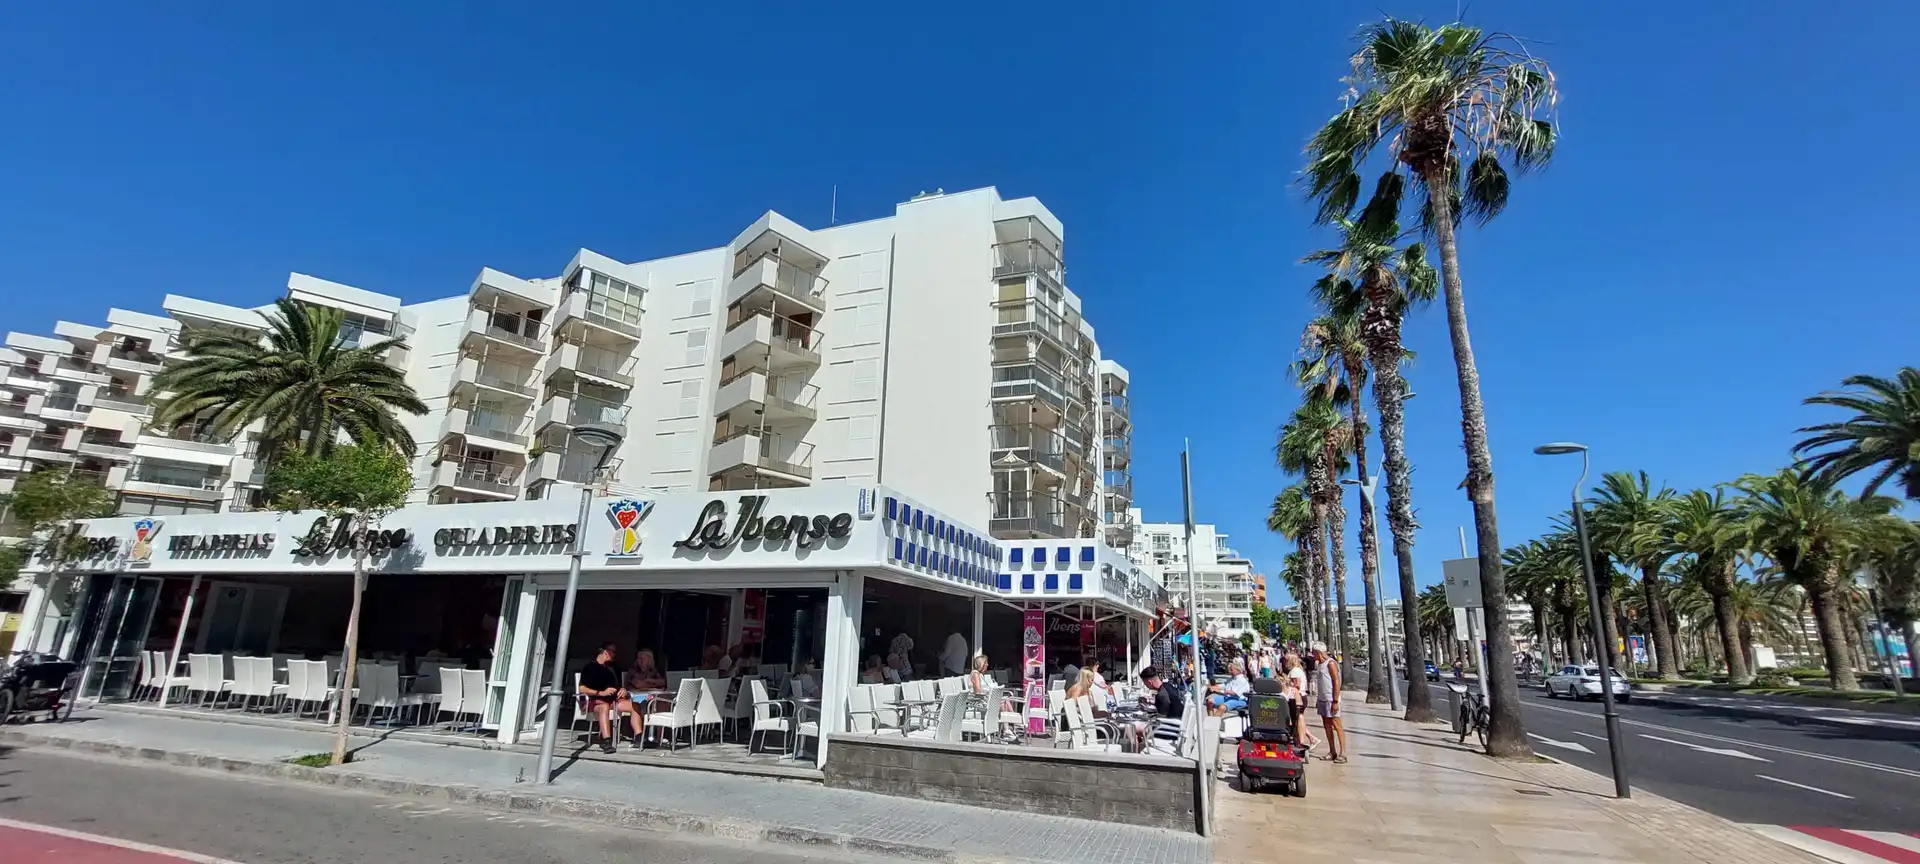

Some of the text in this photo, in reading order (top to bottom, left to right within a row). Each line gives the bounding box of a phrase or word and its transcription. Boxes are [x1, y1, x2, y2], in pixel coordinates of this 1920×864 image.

[673, 499, 726, 549] La
[168, 533, 271, 552] HELADERIAS
[433, 524, 577, 548] GELADERIES
[1047, 617, 1080, 634] Ibens
